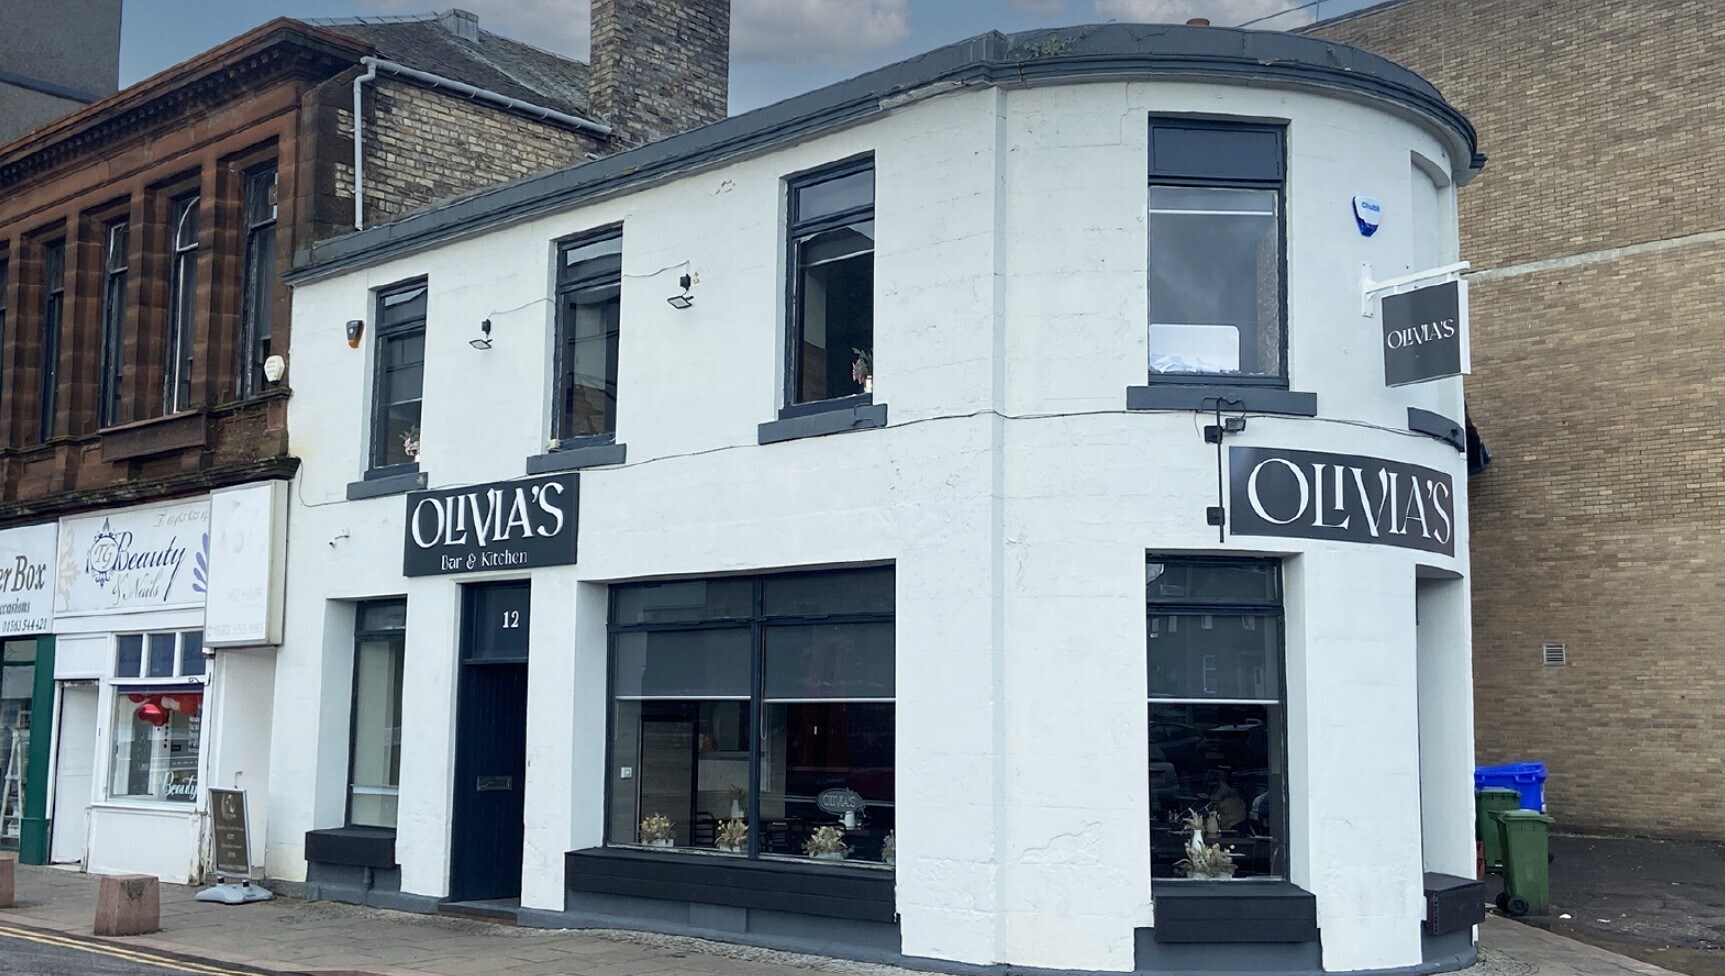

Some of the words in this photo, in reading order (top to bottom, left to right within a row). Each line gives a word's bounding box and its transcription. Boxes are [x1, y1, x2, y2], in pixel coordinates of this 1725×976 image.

[1387, 318, 1455, 349] OLIVIA'S
[411, 482, 565, 549] OLIVIA'S
[1247, 457, 1451, 545] OLIVIA'S
[11, 554, 47, 592] Box
[112, 531, 187, 602] Beauty
[441, 554, 462, 571] Bar
[466, 552, 477, 570] &
[481, 549, 528, 567] Kitchen
[123, 568, 164, 601] Nails
[502, 610, 520, 628] 12
[162, 770, 198, 800] Beauty
